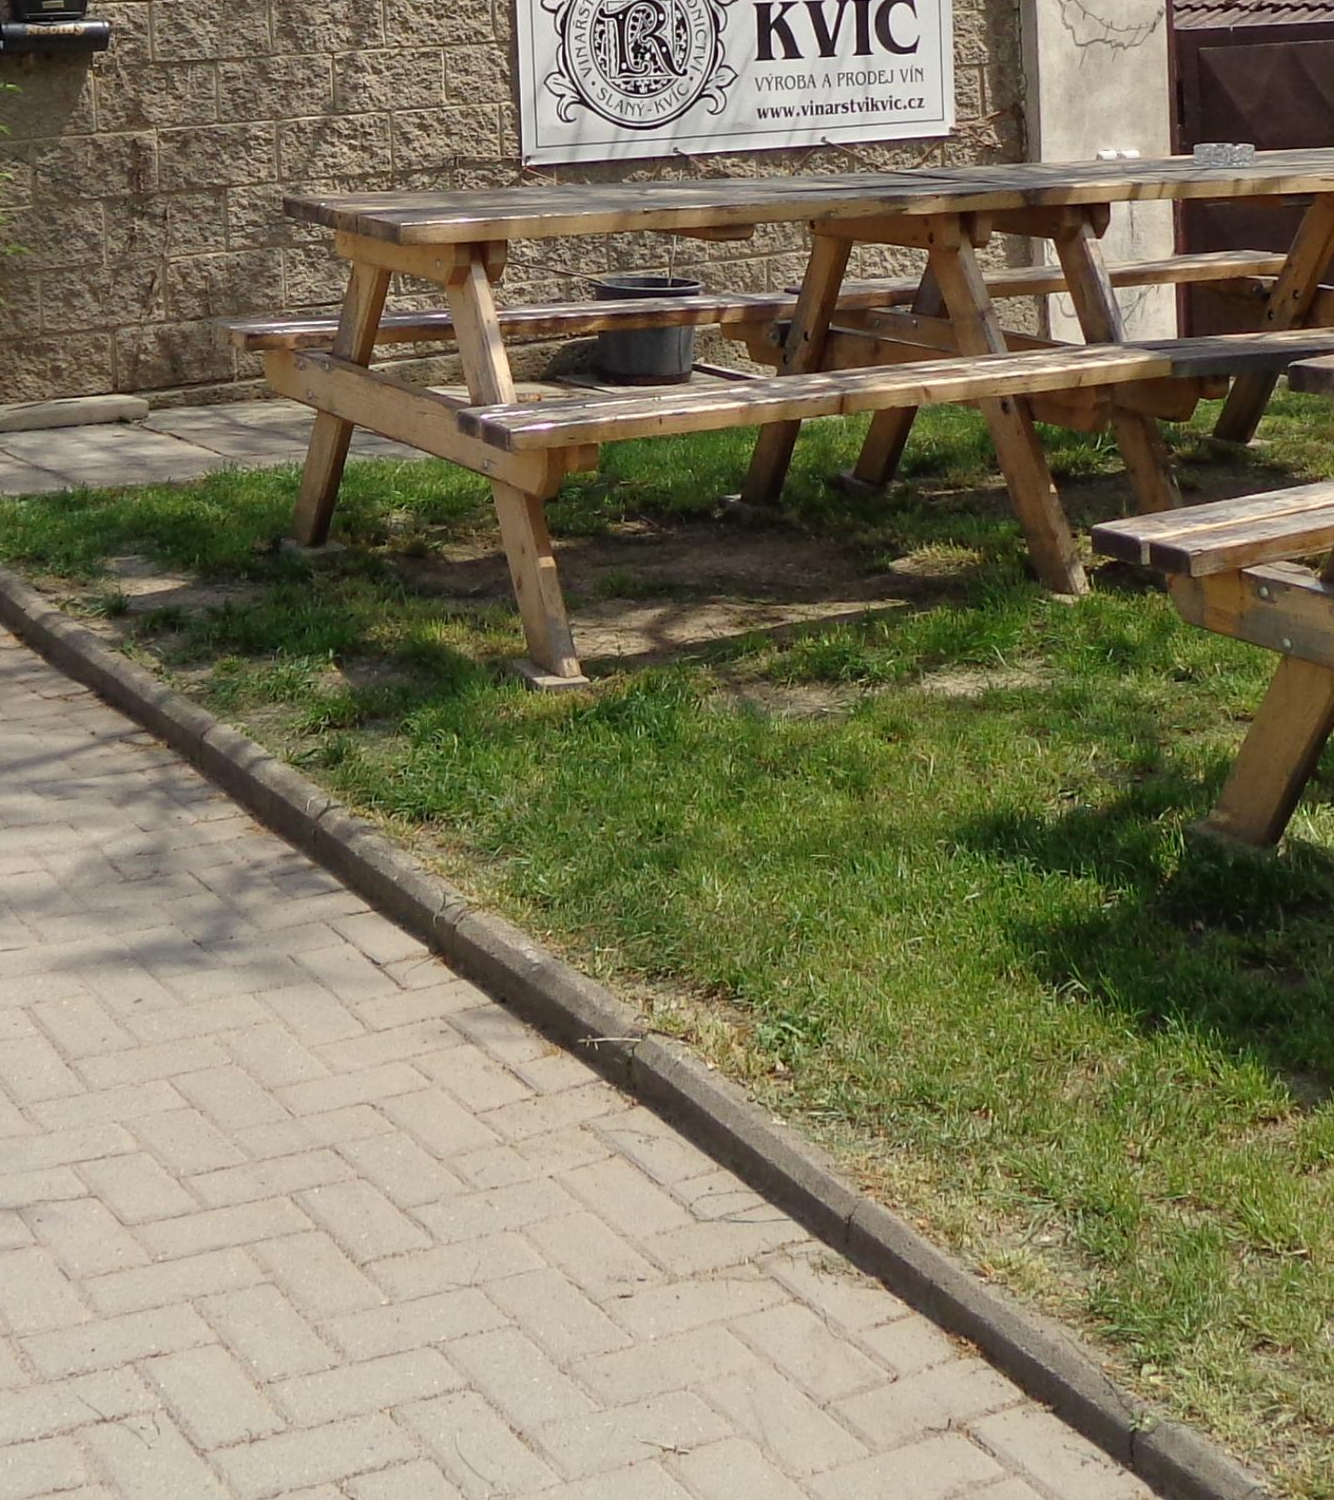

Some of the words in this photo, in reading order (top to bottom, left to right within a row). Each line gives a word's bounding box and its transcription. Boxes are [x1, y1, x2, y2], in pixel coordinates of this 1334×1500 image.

[755, 73, 817, 92] VÝROBA
[822, 73, 832, 88] A
[837, 69, 894, 87] PRODEJ
[900, 65, 924, 83] VÍN
[757, 95, 925, 120] www.vinarstvikvic.cz
